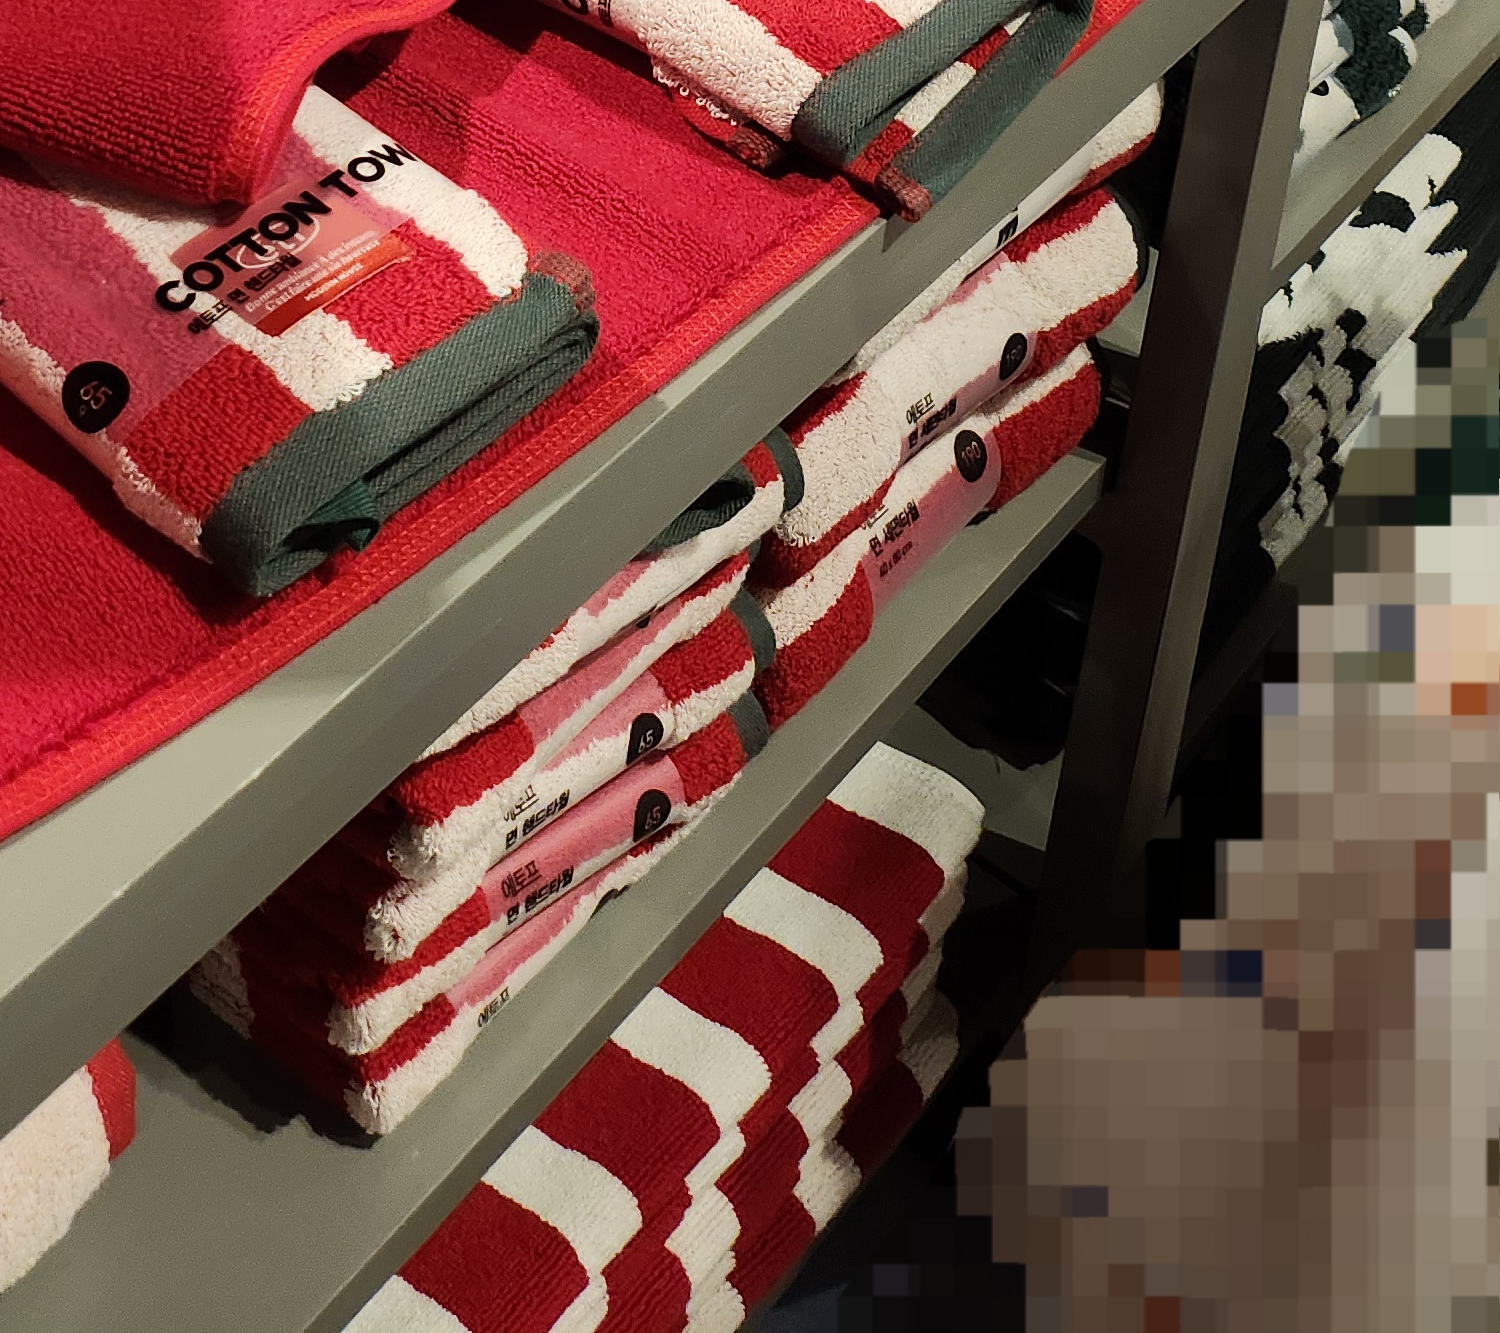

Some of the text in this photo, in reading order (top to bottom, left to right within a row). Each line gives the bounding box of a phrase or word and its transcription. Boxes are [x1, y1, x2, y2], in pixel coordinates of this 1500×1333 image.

[156, 190, 332, 312] COTTON
[302, 261, 363, 302] MODERN HOUSE
[228, 288, 249, 304] 면
[80, 381, 112, 409] 65
[906, 392, 935, 425] 에토프
[961, 440, 982, 467] 190
[869, 536, 884, 558] 면
[883, 498, 921, 544] 세면타월
[637, 728, 656, 755] 65
[643, 805, 662, 832] 65
[505, 824, 519, 851] 면
[500, 860, 542, 900] 에토프
[506, 900, 520, 925] 면
